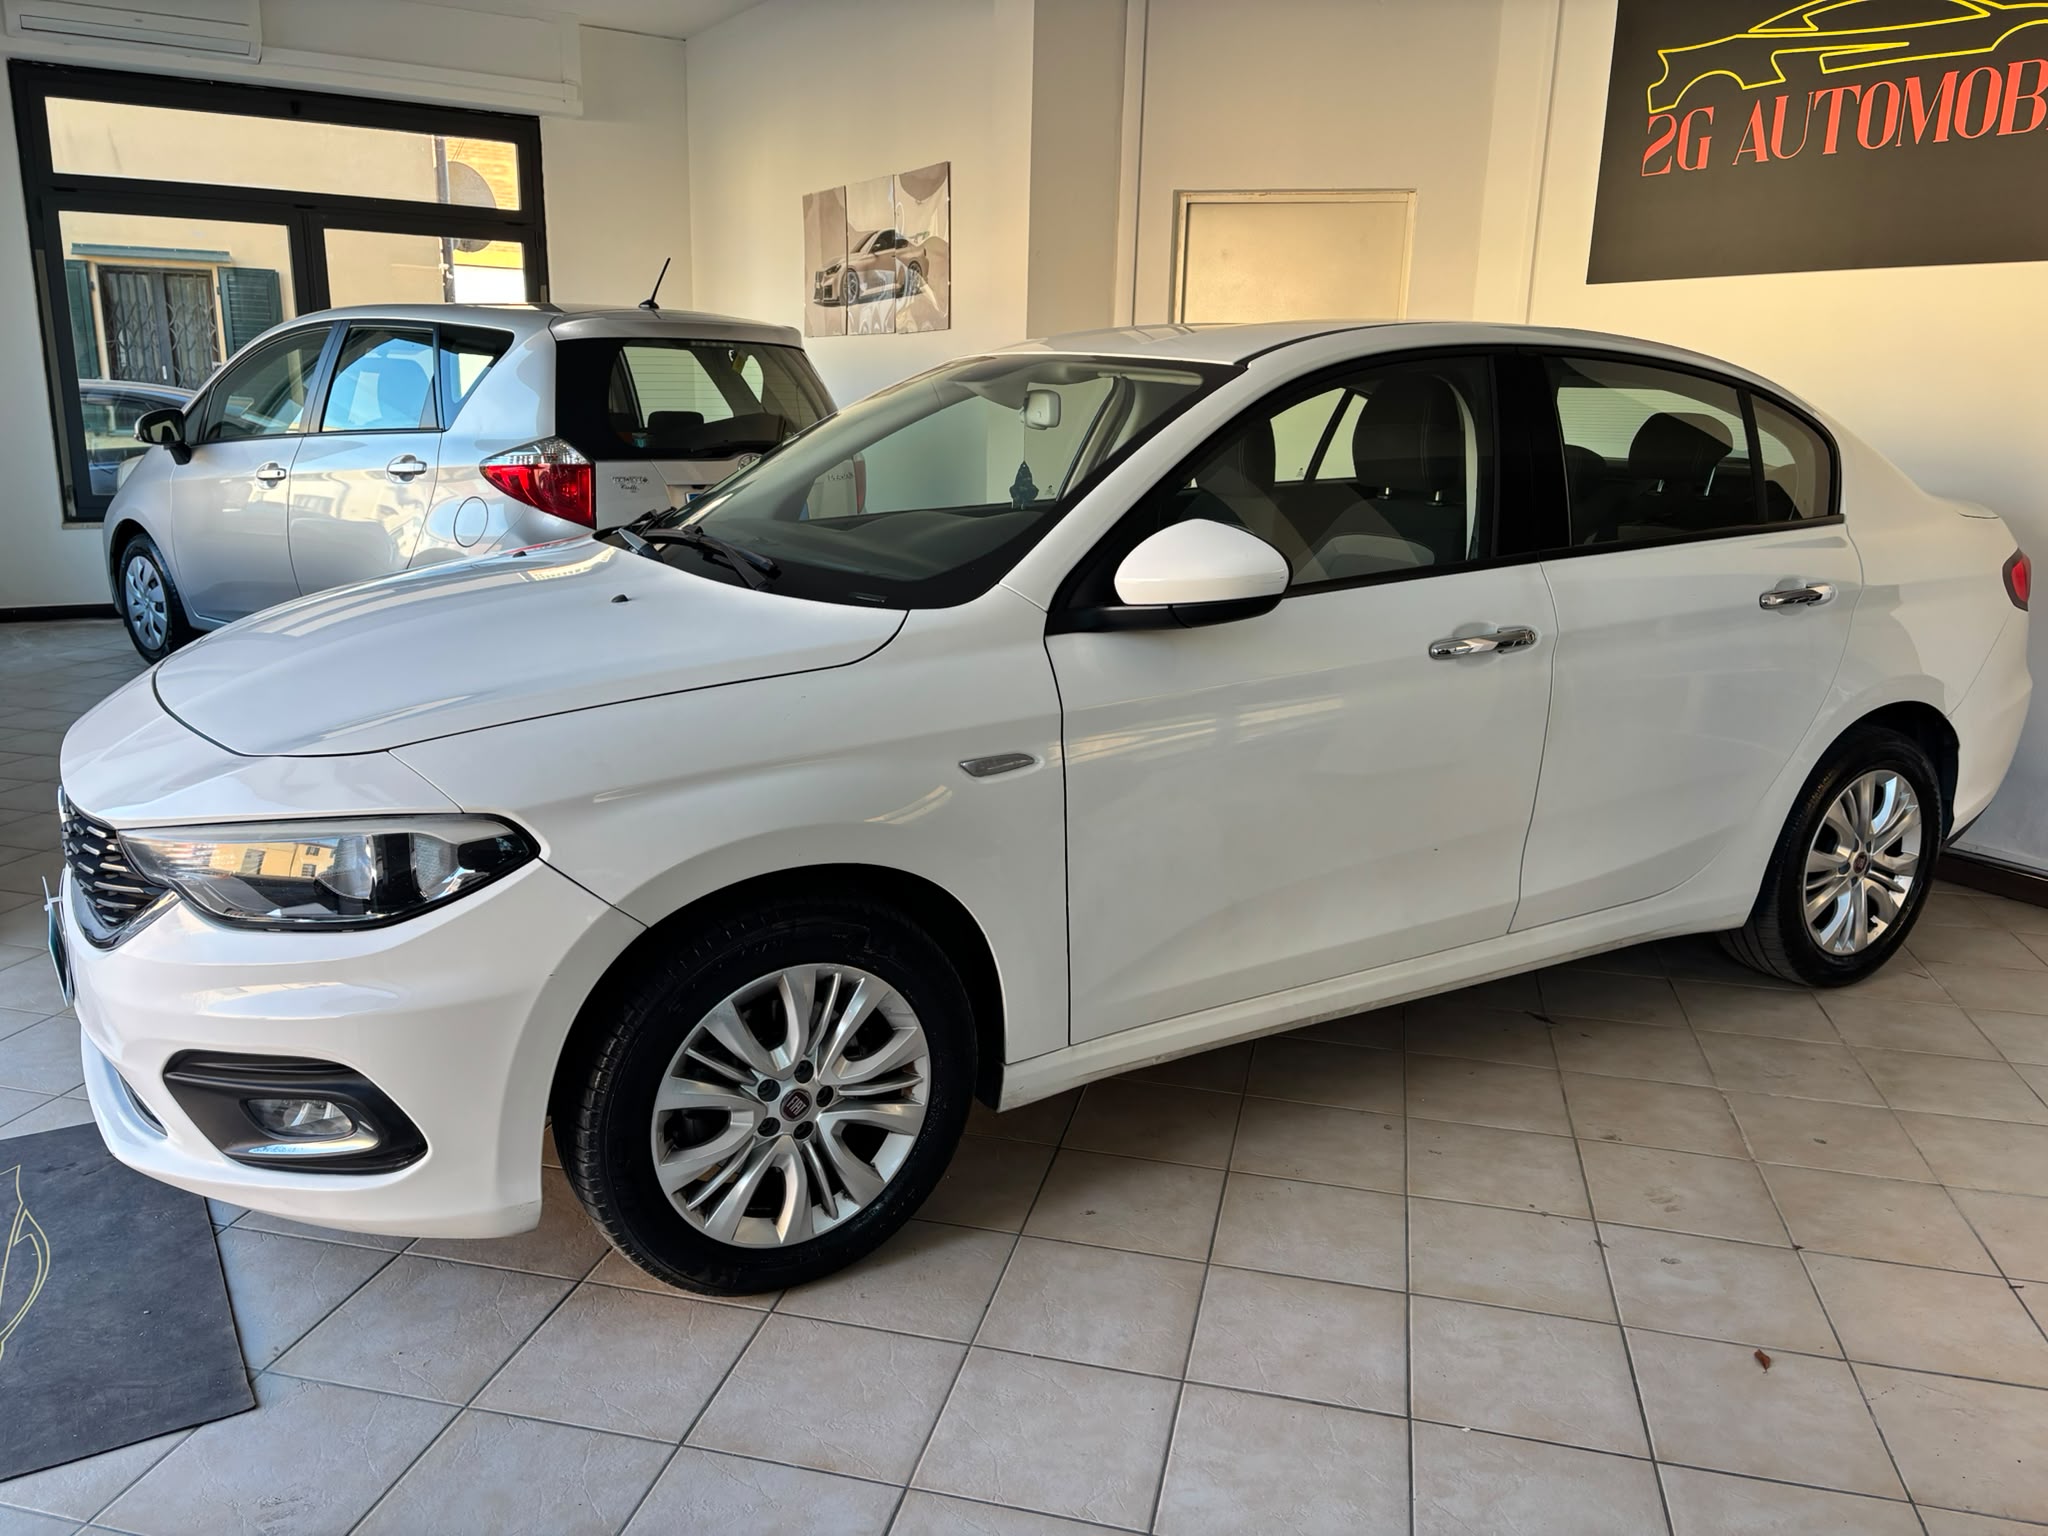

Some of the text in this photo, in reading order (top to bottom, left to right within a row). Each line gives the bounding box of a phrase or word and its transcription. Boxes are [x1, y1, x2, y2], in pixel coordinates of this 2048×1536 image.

[1641, 58, 2048, 177] 2G AUTOMOB
[786, 1095, 807, 1116] FIAT
